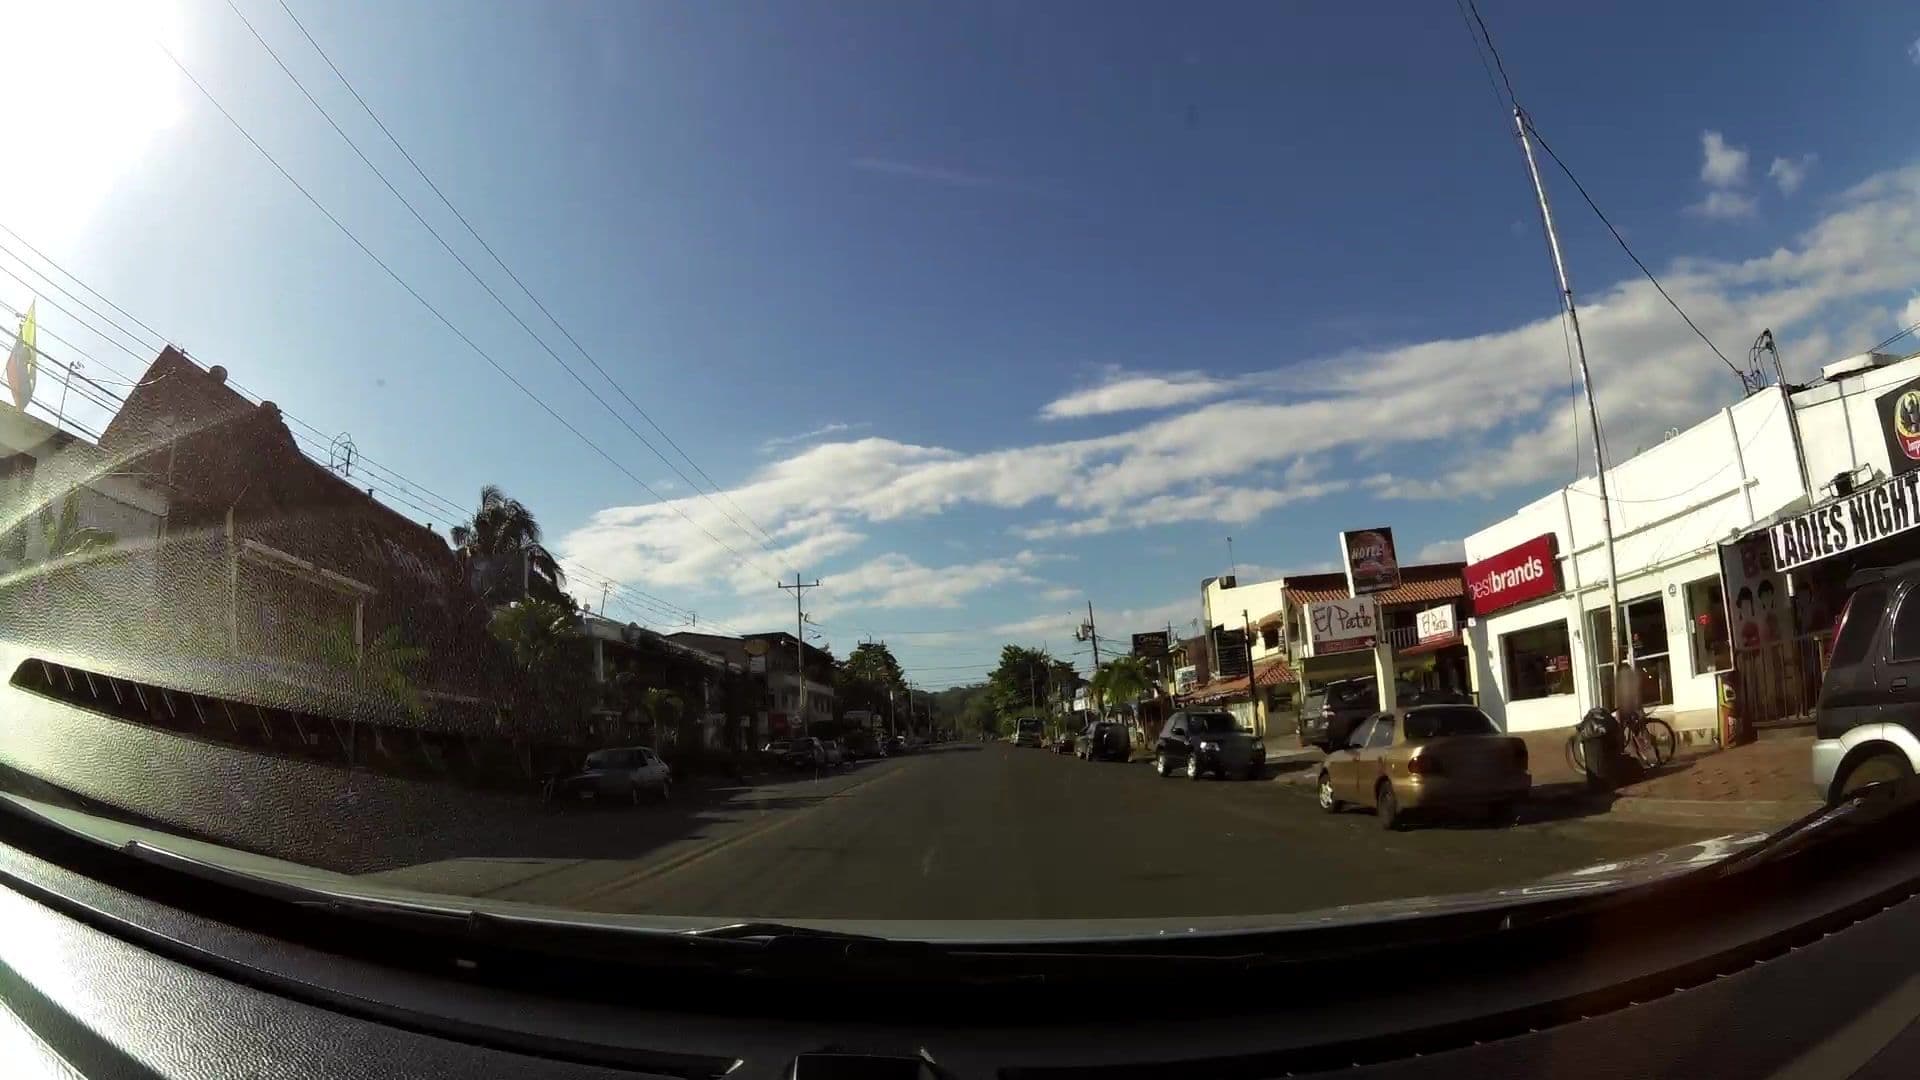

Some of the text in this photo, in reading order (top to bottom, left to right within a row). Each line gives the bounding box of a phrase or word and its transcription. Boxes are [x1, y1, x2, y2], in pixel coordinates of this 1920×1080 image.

[1770, 505, 1848, 570] LADIES
[1849, 474, 1920, 545] NIGHT
[1467, 556, 1543, 601] bestbrands
[1312, 605, 1333, 637] El
